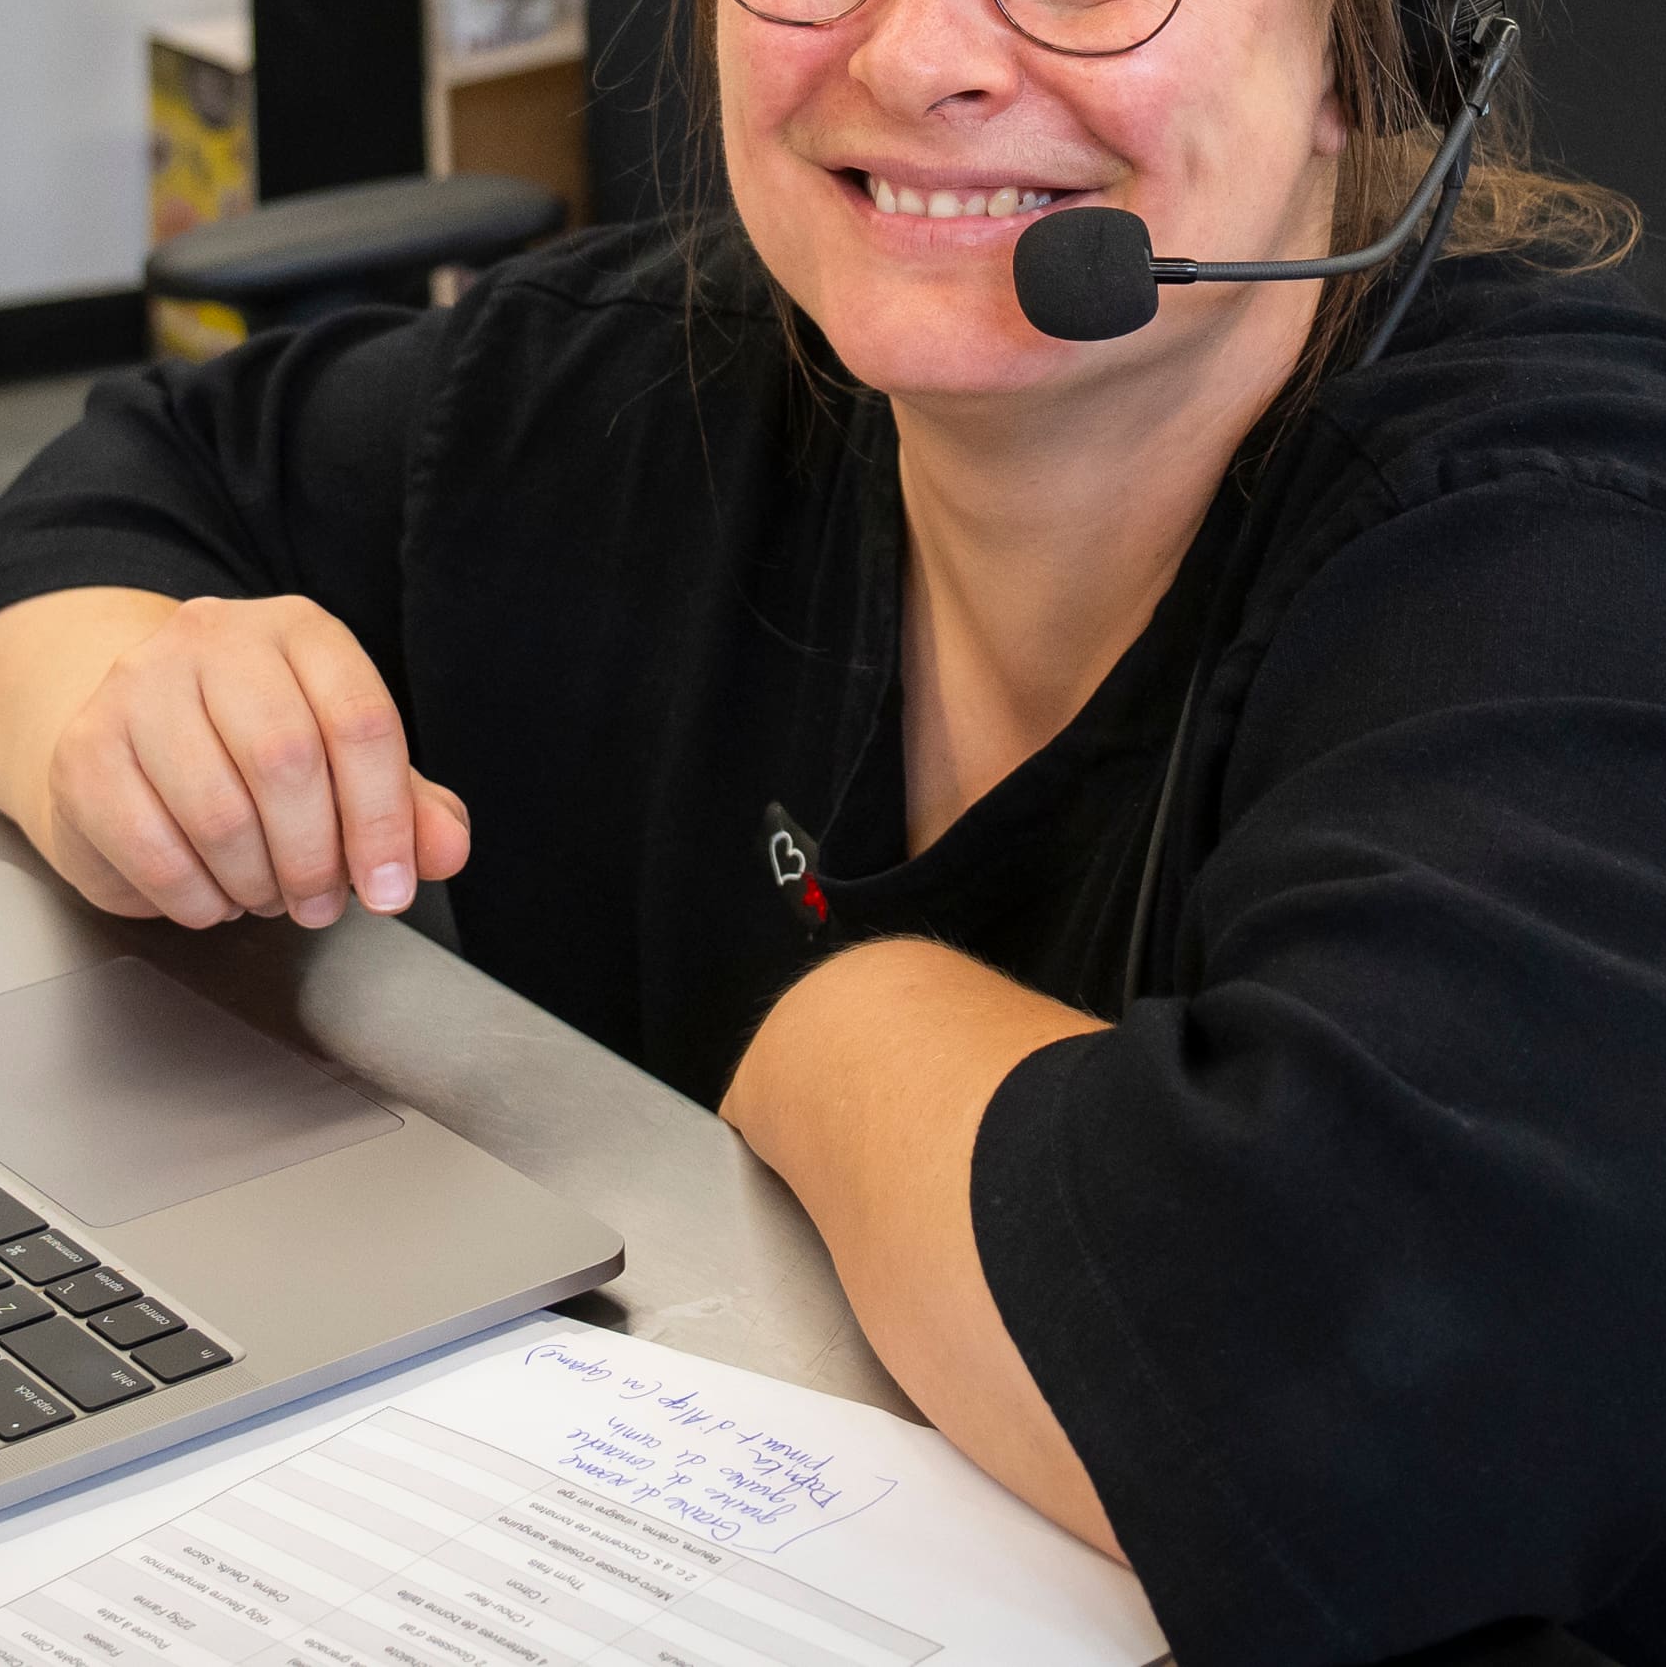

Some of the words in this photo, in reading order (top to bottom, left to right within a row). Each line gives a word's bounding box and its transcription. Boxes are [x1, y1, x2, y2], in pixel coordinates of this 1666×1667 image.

[39, 1233, 83, 1263] command
[95, 1272, 125, 1292] option
[133, 1302, 170, 1325] control
[201, 1347, 216, 1359] fn
[111, 1368, 137, 1387] shift
[14, 1384, 35, 1403] lock
[33, 1397, 57, 1416] caps
[676, 1449, 707, 1467] de
[662, 1471, 692, 1489] de
[748, 1449, 842, 1508] Paprika
[557, 1485, 577, 1499] rge
[630, 1483, 661, 1504] de
[529, 1501, 574, 1526] tomates
[576, 1497, 594, 1510] vin
[595, 1504, 638, 1527] vinaigre
[498, 1515, 549, 1545] sanguine
[574, 1521, 591, 1534] de
[548, 1539, 595, 1564] d'oseille
[592, 1529, 650, 1560] Concentré
[183, 1546, 215, 1565] Sucre
[217, 1562, 250, 1583] Oeufs,
[527, 1558, 554, 1575] frais
[553, 1567, 586, 1590] Thym
[594, 1559, 674, 1602] Micro-pousse
[686, 1574, 698, 1582] 2
[397, 1589, 424, 1608] taille
[506, 1578, 542, 1601] Citron
[133, 1594, 169, 1615] Farine
[210, 1590, 246, 1613] Beurre
[465, 1591, 526, 1624] Chou-fleur
[167, 1612, 196, 1631] 225g
[246, 1608, 272, 1626] 160g
[425, 1602, 461, 1624] bonne
[397, 1622, 426, 1638] d'ail
[461, 1619, 477, 1632] de
[21, 1631, 55, 1653] Citron
[83, 1632, 124, 1658] Fraises
[132, 1626, 171, 1651] Poudre
[426, 1632, 476, 1663] Gousses
[477, 1627, 539, 1663] Betteraves
[305, 1639, 353, 1663] grenade
